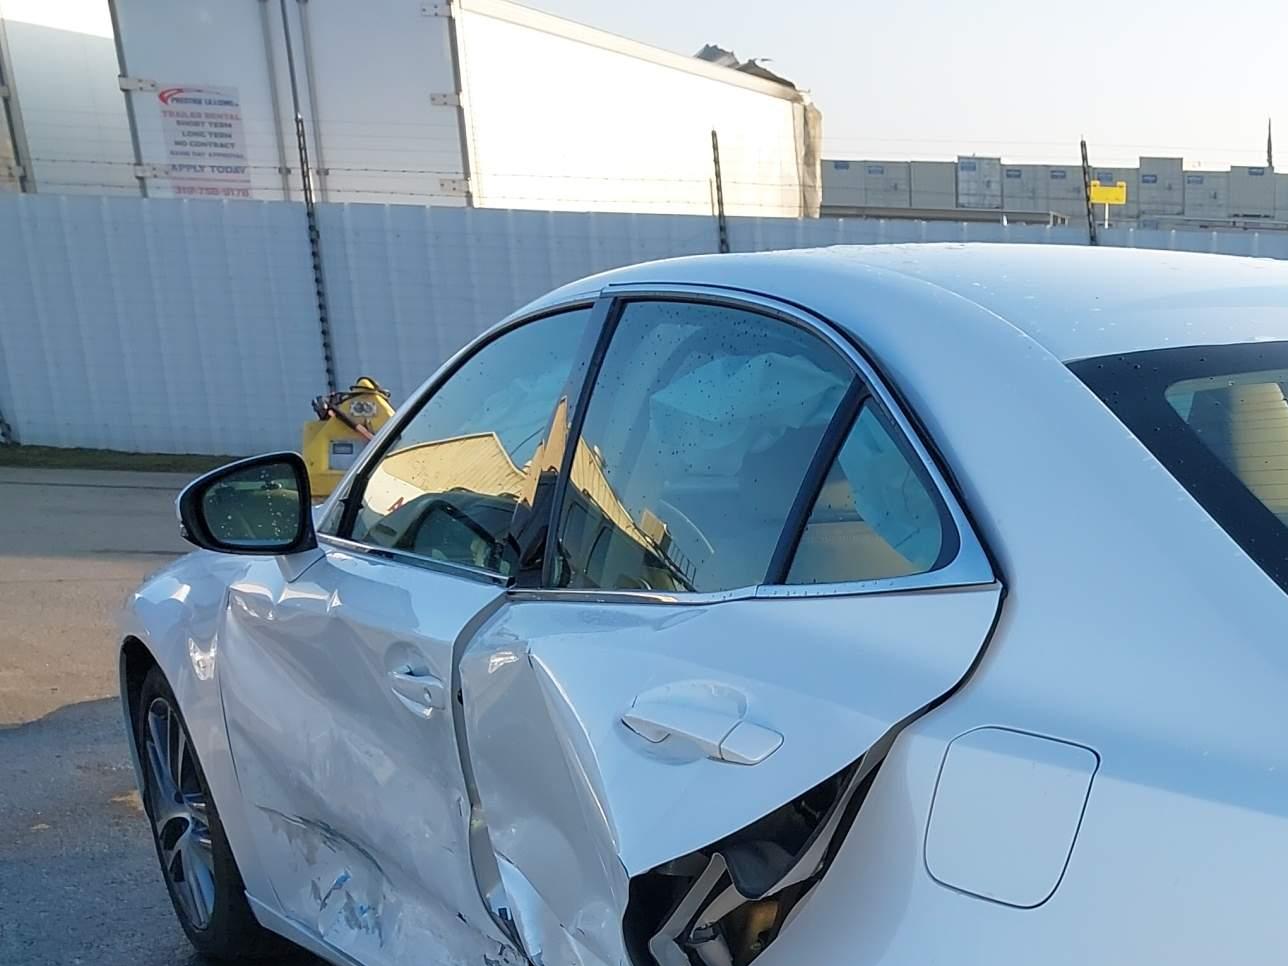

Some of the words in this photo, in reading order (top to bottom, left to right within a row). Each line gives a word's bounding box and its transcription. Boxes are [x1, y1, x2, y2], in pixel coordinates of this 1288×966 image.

[162, 111, 202, 119] TRAILER
[204, 112, 242, 120] RENTAL
[189, 141, 236, 149] CONTRACT
[171, 164, 205, 173] APPLY
[210, 165, 247, 174] TODAY
